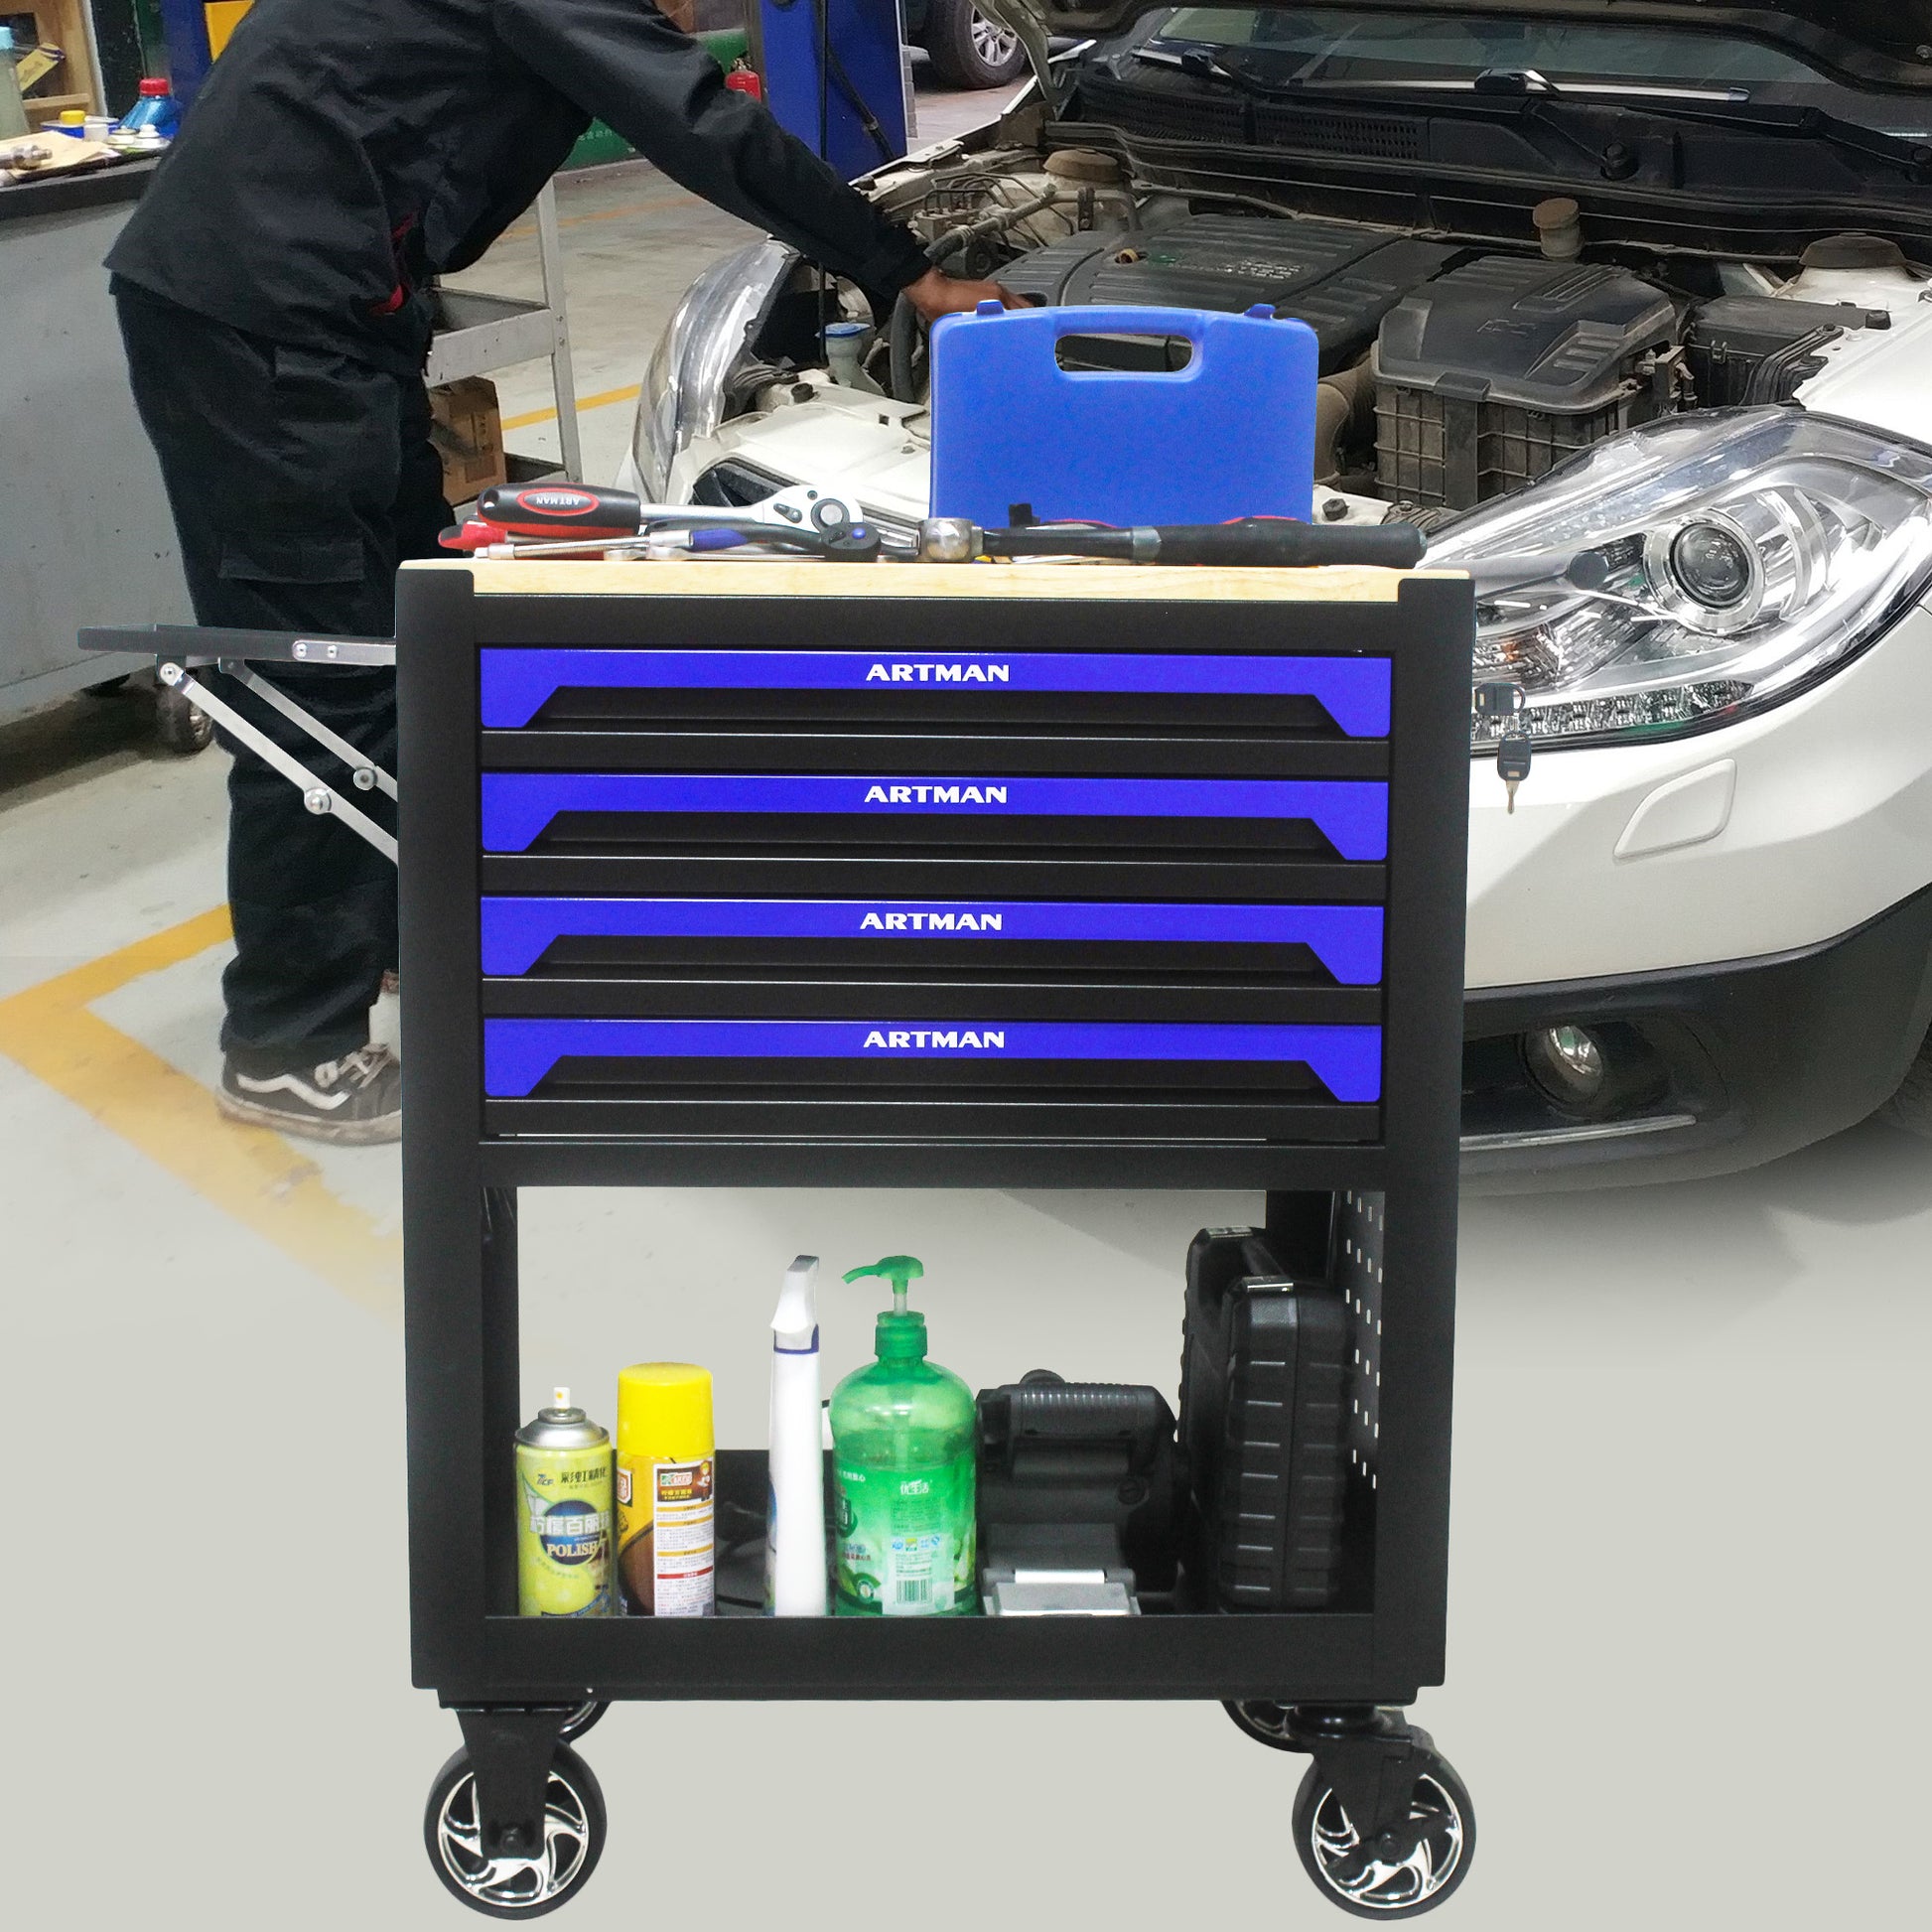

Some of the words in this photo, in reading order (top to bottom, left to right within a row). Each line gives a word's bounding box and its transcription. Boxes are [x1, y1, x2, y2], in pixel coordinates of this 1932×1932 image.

[536, 495, 580, 506] ARTMAN
[866, 664, 1010, 682] ARTMAN
[865, 785, 1008, 803] ARTMAN
[860, 912, 1003, 930] ARTMAN
[864, 1031, 1005, 1048] ARTMAN
[547, 1541, 598, 1557] POLISH
